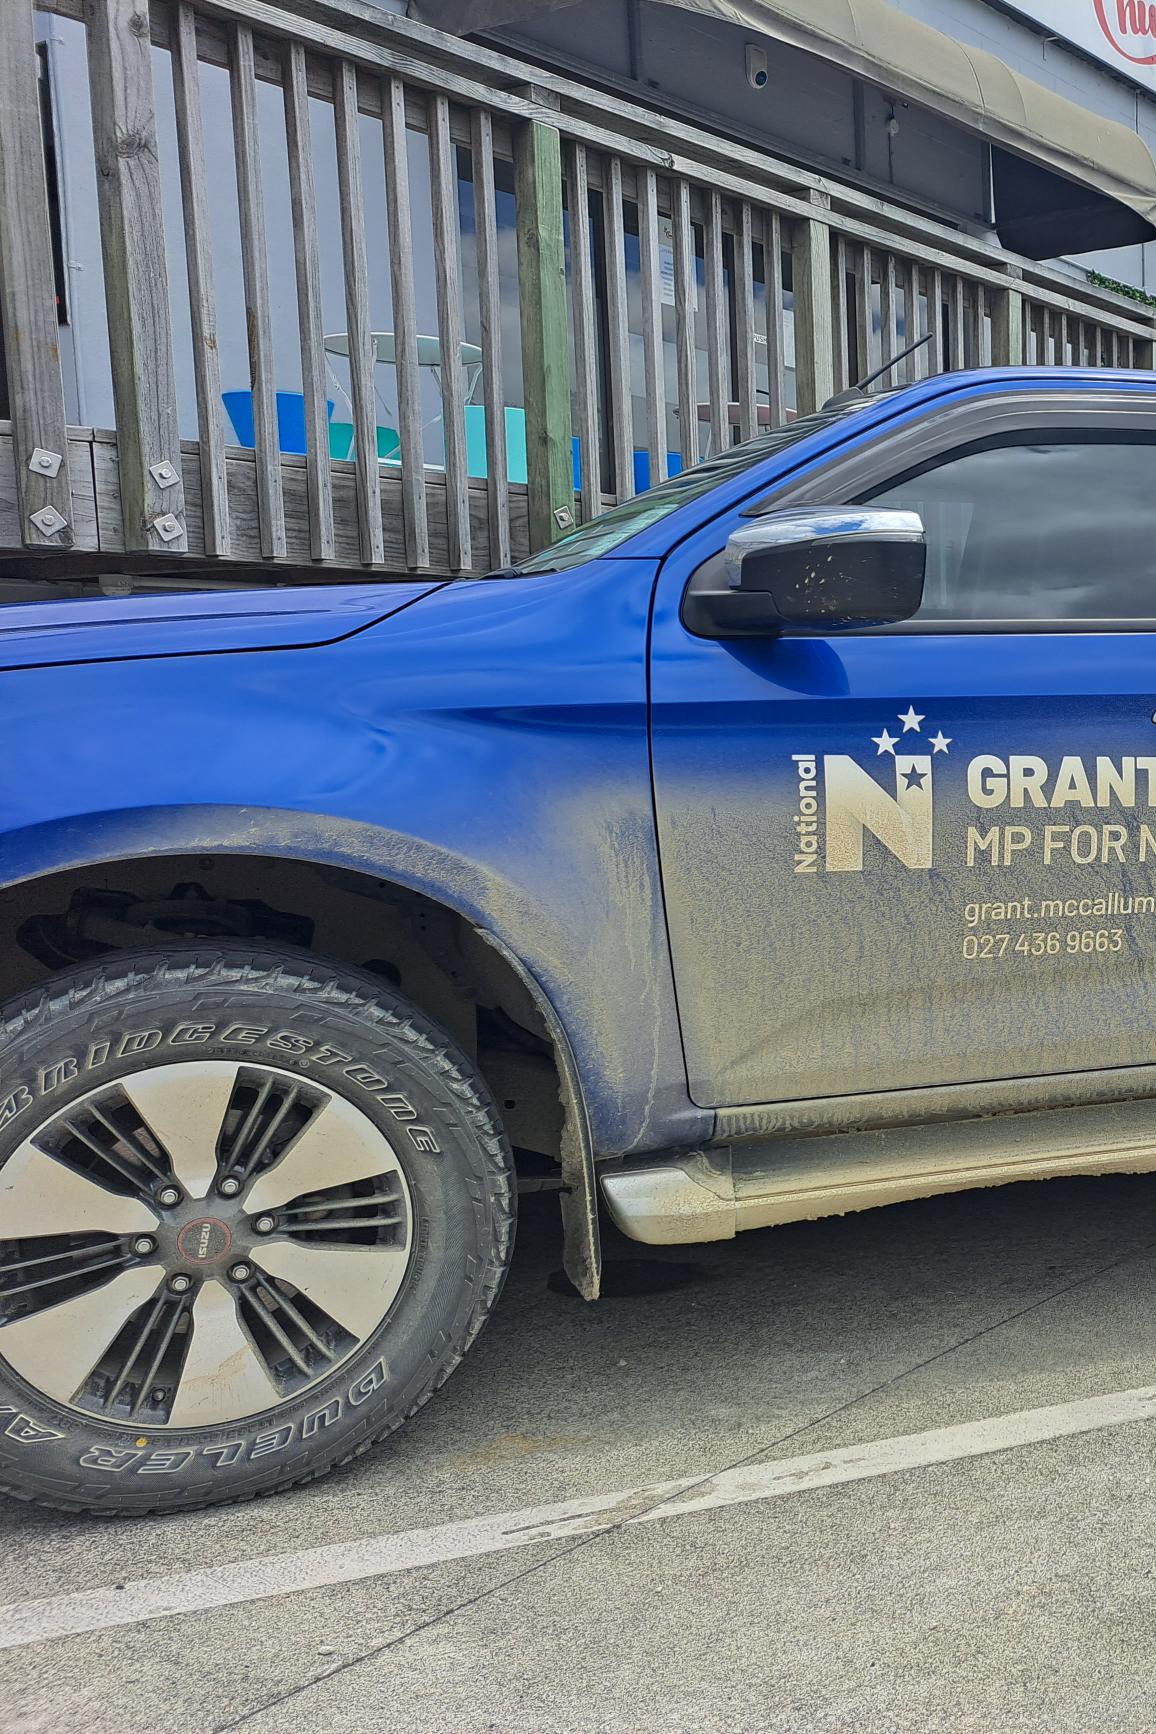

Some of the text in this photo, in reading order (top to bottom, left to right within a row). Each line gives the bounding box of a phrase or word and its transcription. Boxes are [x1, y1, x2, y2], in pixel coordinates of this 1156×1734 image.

[792, 754, 818, 873] National
[966, 825, 1032, 867] MP
[1043, 823, 1128, 865] FOR
[962, 928, 1124, 959] 027 436 9663
[0, 1022, 441, 1155] BRIDGESTONE
[198, 1223, 211, 1258] ISUZU
[80, 1356, 390, 1475] DUELER
